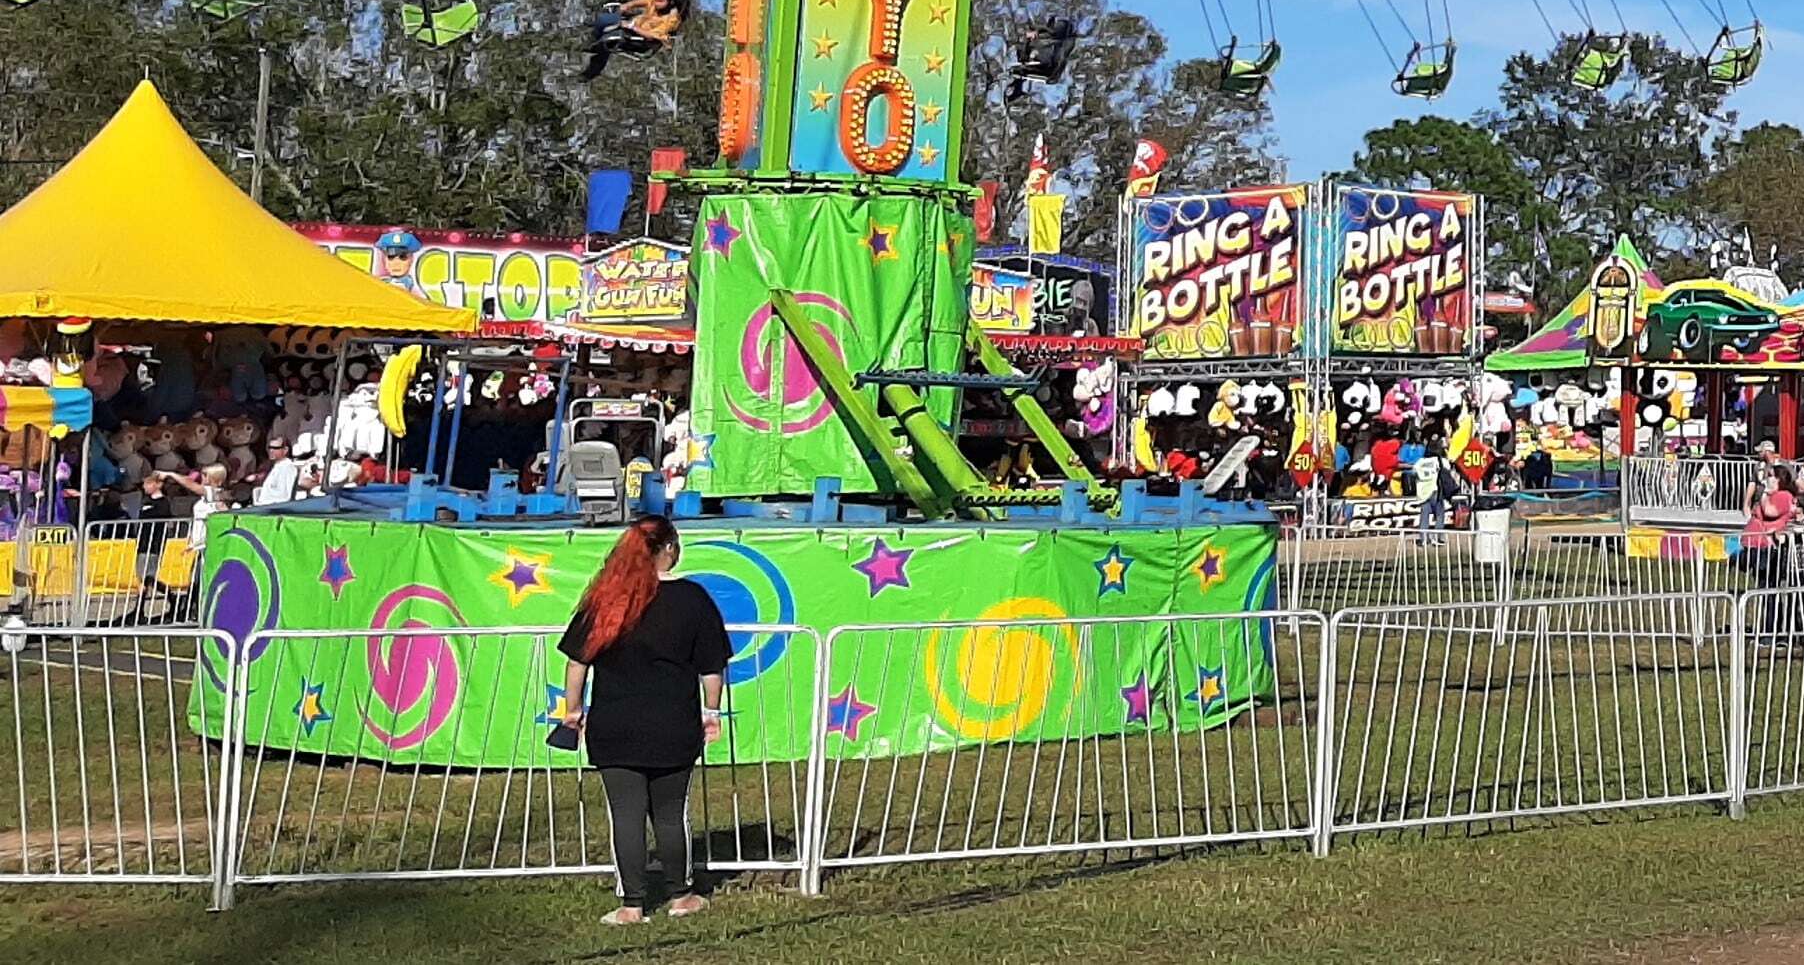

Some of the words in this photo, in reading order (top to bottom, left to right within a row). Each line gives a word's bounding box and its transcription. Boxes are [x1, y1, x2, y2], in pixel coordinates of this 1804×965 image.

[594, 259, 689, 280] WATER
[1143, 211, 1252, 283] RING
[1260, 196, 1293, 239] A
[1343, 213, 1431, 274] RING
[1439, 202, 1462, 240] A
[415, 247, 585, 322] STOP
[594, 285, 642, 309] GUN
[645, 283, 686, 308] FUN
[1140, 236, 1294, 333] BOTTLE
[1339, 243, 1464, 325] BOTTLE
[37, 528, 67, 544] EXIT
